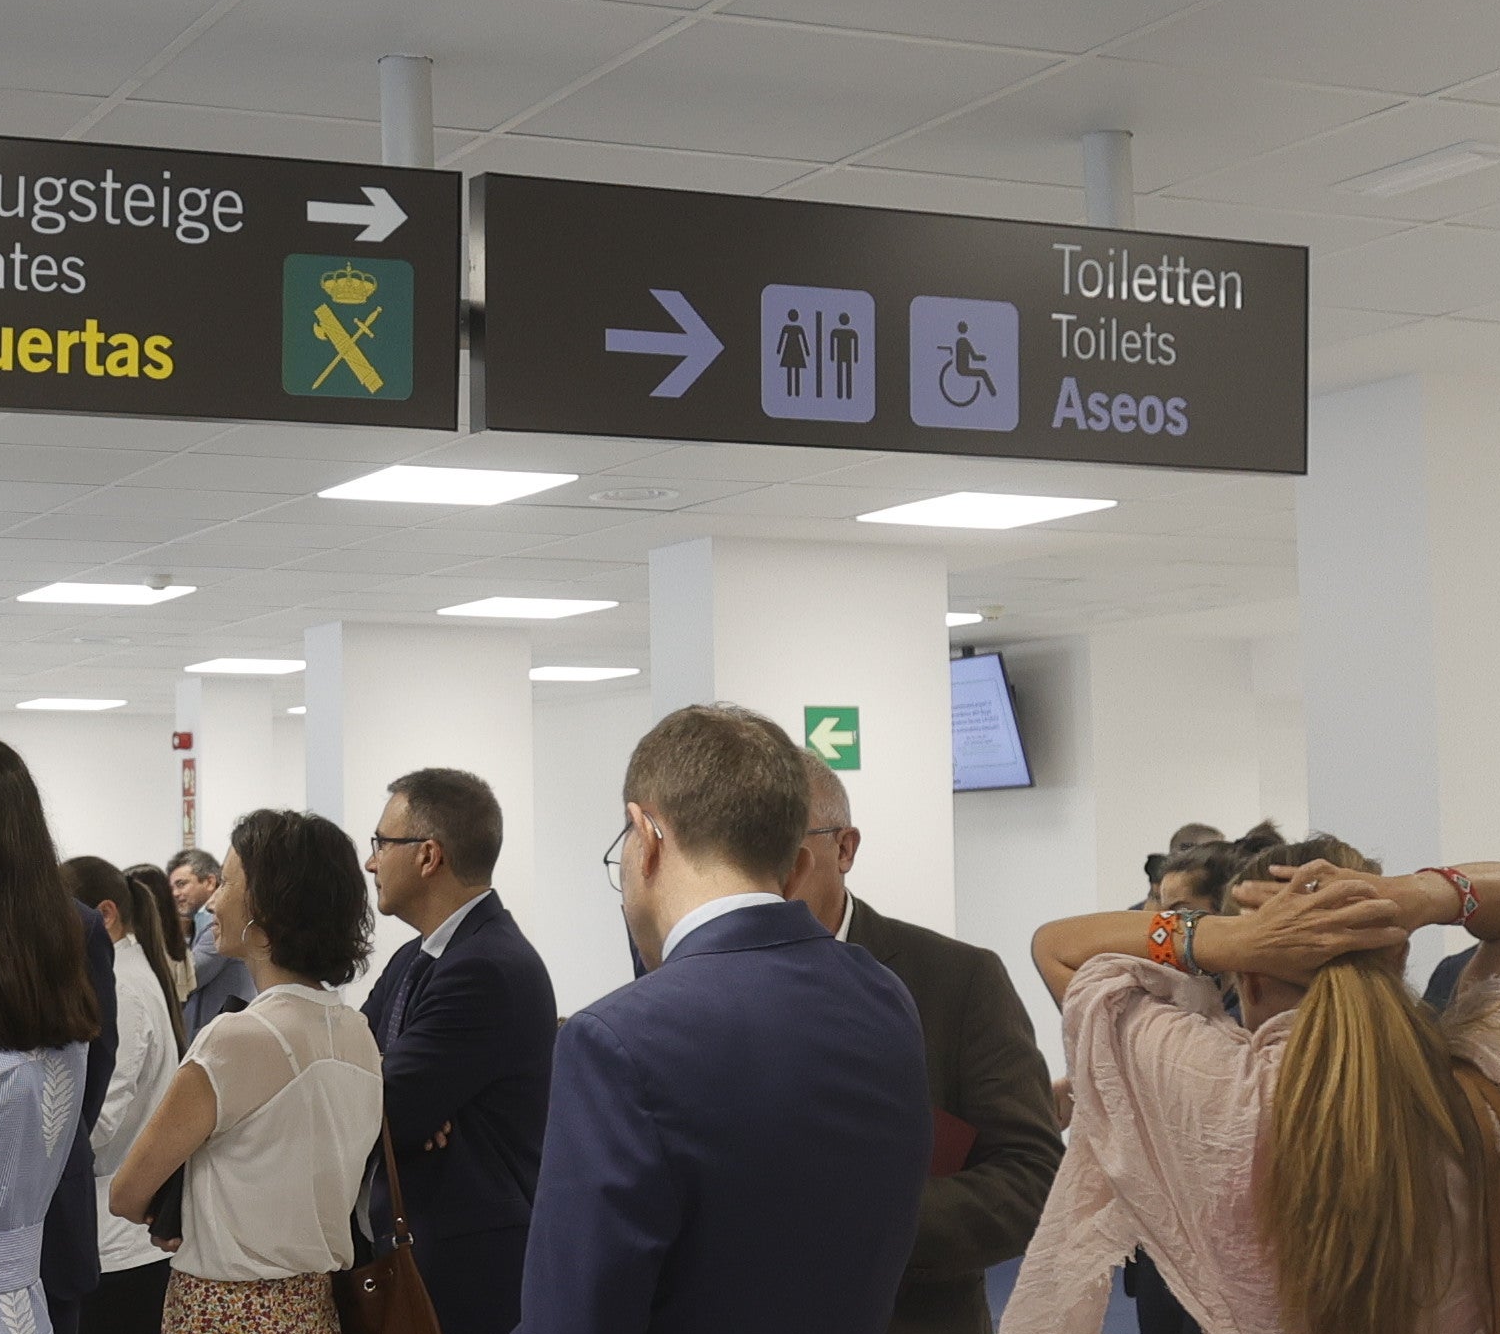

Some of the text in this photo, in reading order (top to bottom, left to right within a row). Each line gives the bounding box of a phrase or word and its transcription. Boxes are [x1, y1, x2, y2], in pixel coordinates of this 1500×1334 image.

[1053, 242, 1243, 310] Toiletten
[1051, 312, 1177, 366] Toilets
[1052, 376, 1189, 436] Aseos
